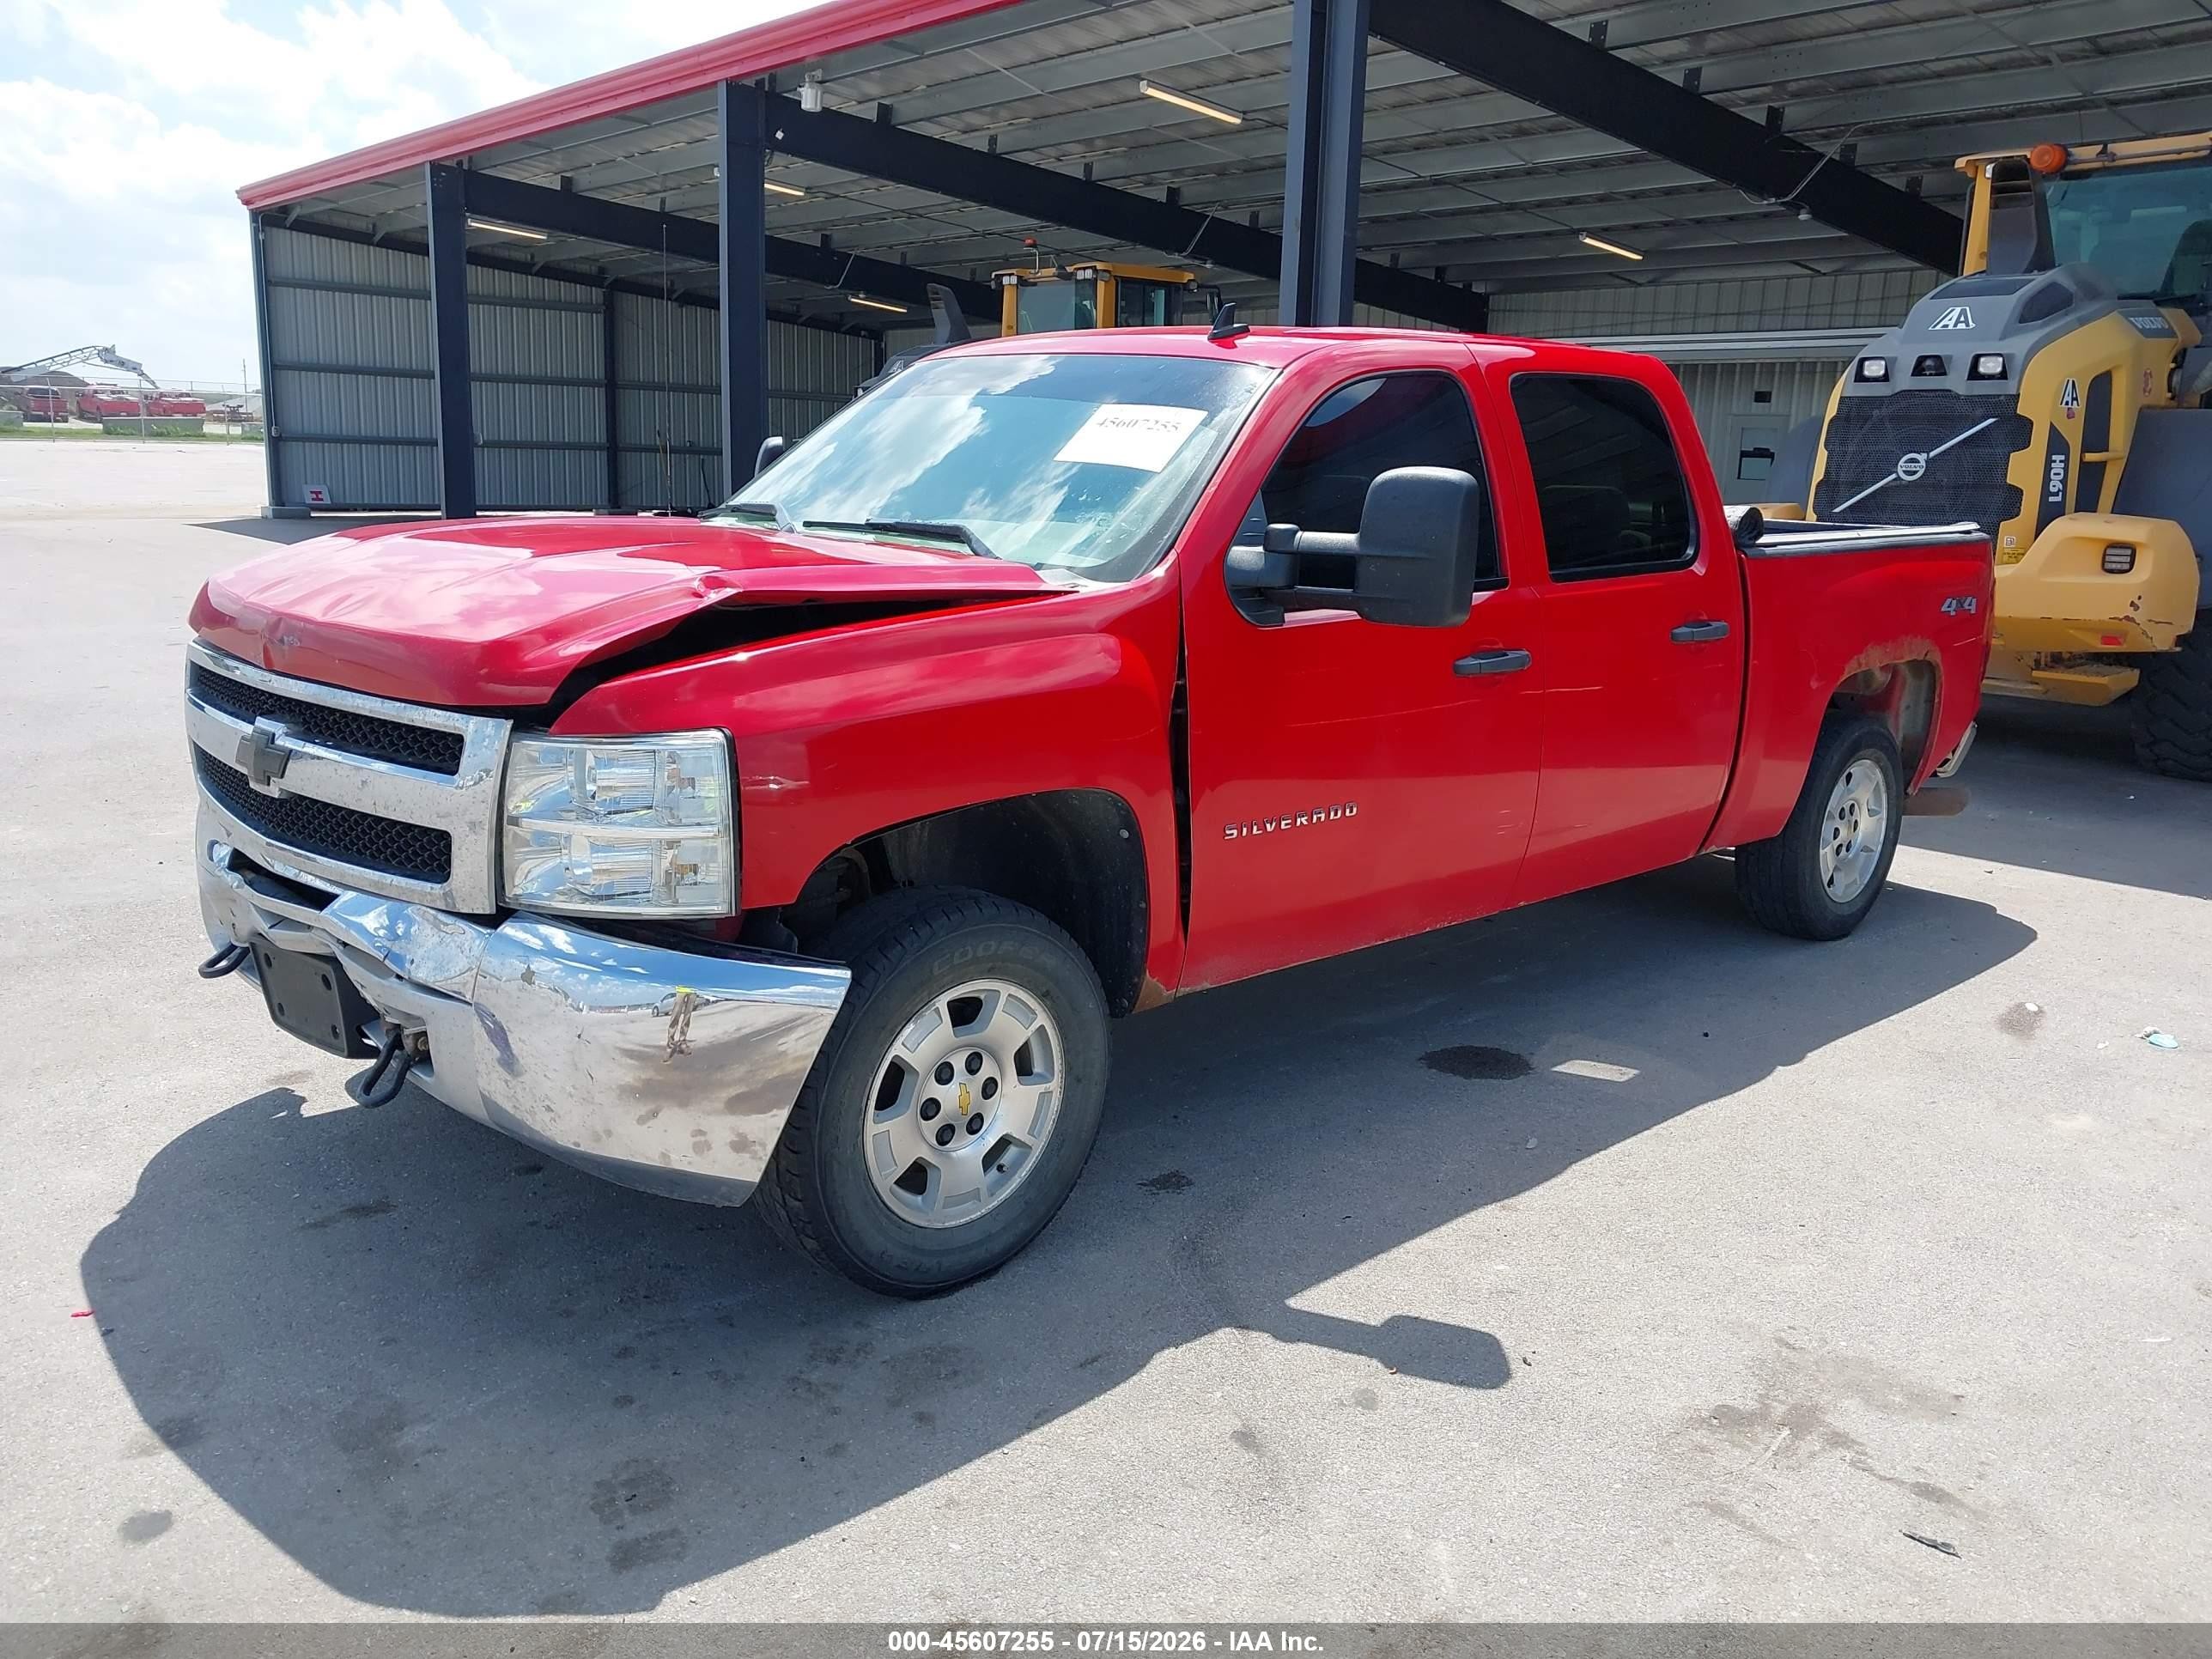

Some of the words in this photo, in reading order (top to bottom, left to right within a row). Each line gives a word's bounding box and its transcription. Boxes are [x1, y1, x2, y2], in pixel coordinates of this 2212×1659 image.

[2129, 317, 2169, 329] VOLVO
[2049, 455, 2065, 502] L90H
[1224, 802, 1358, 839] SILVERADO
